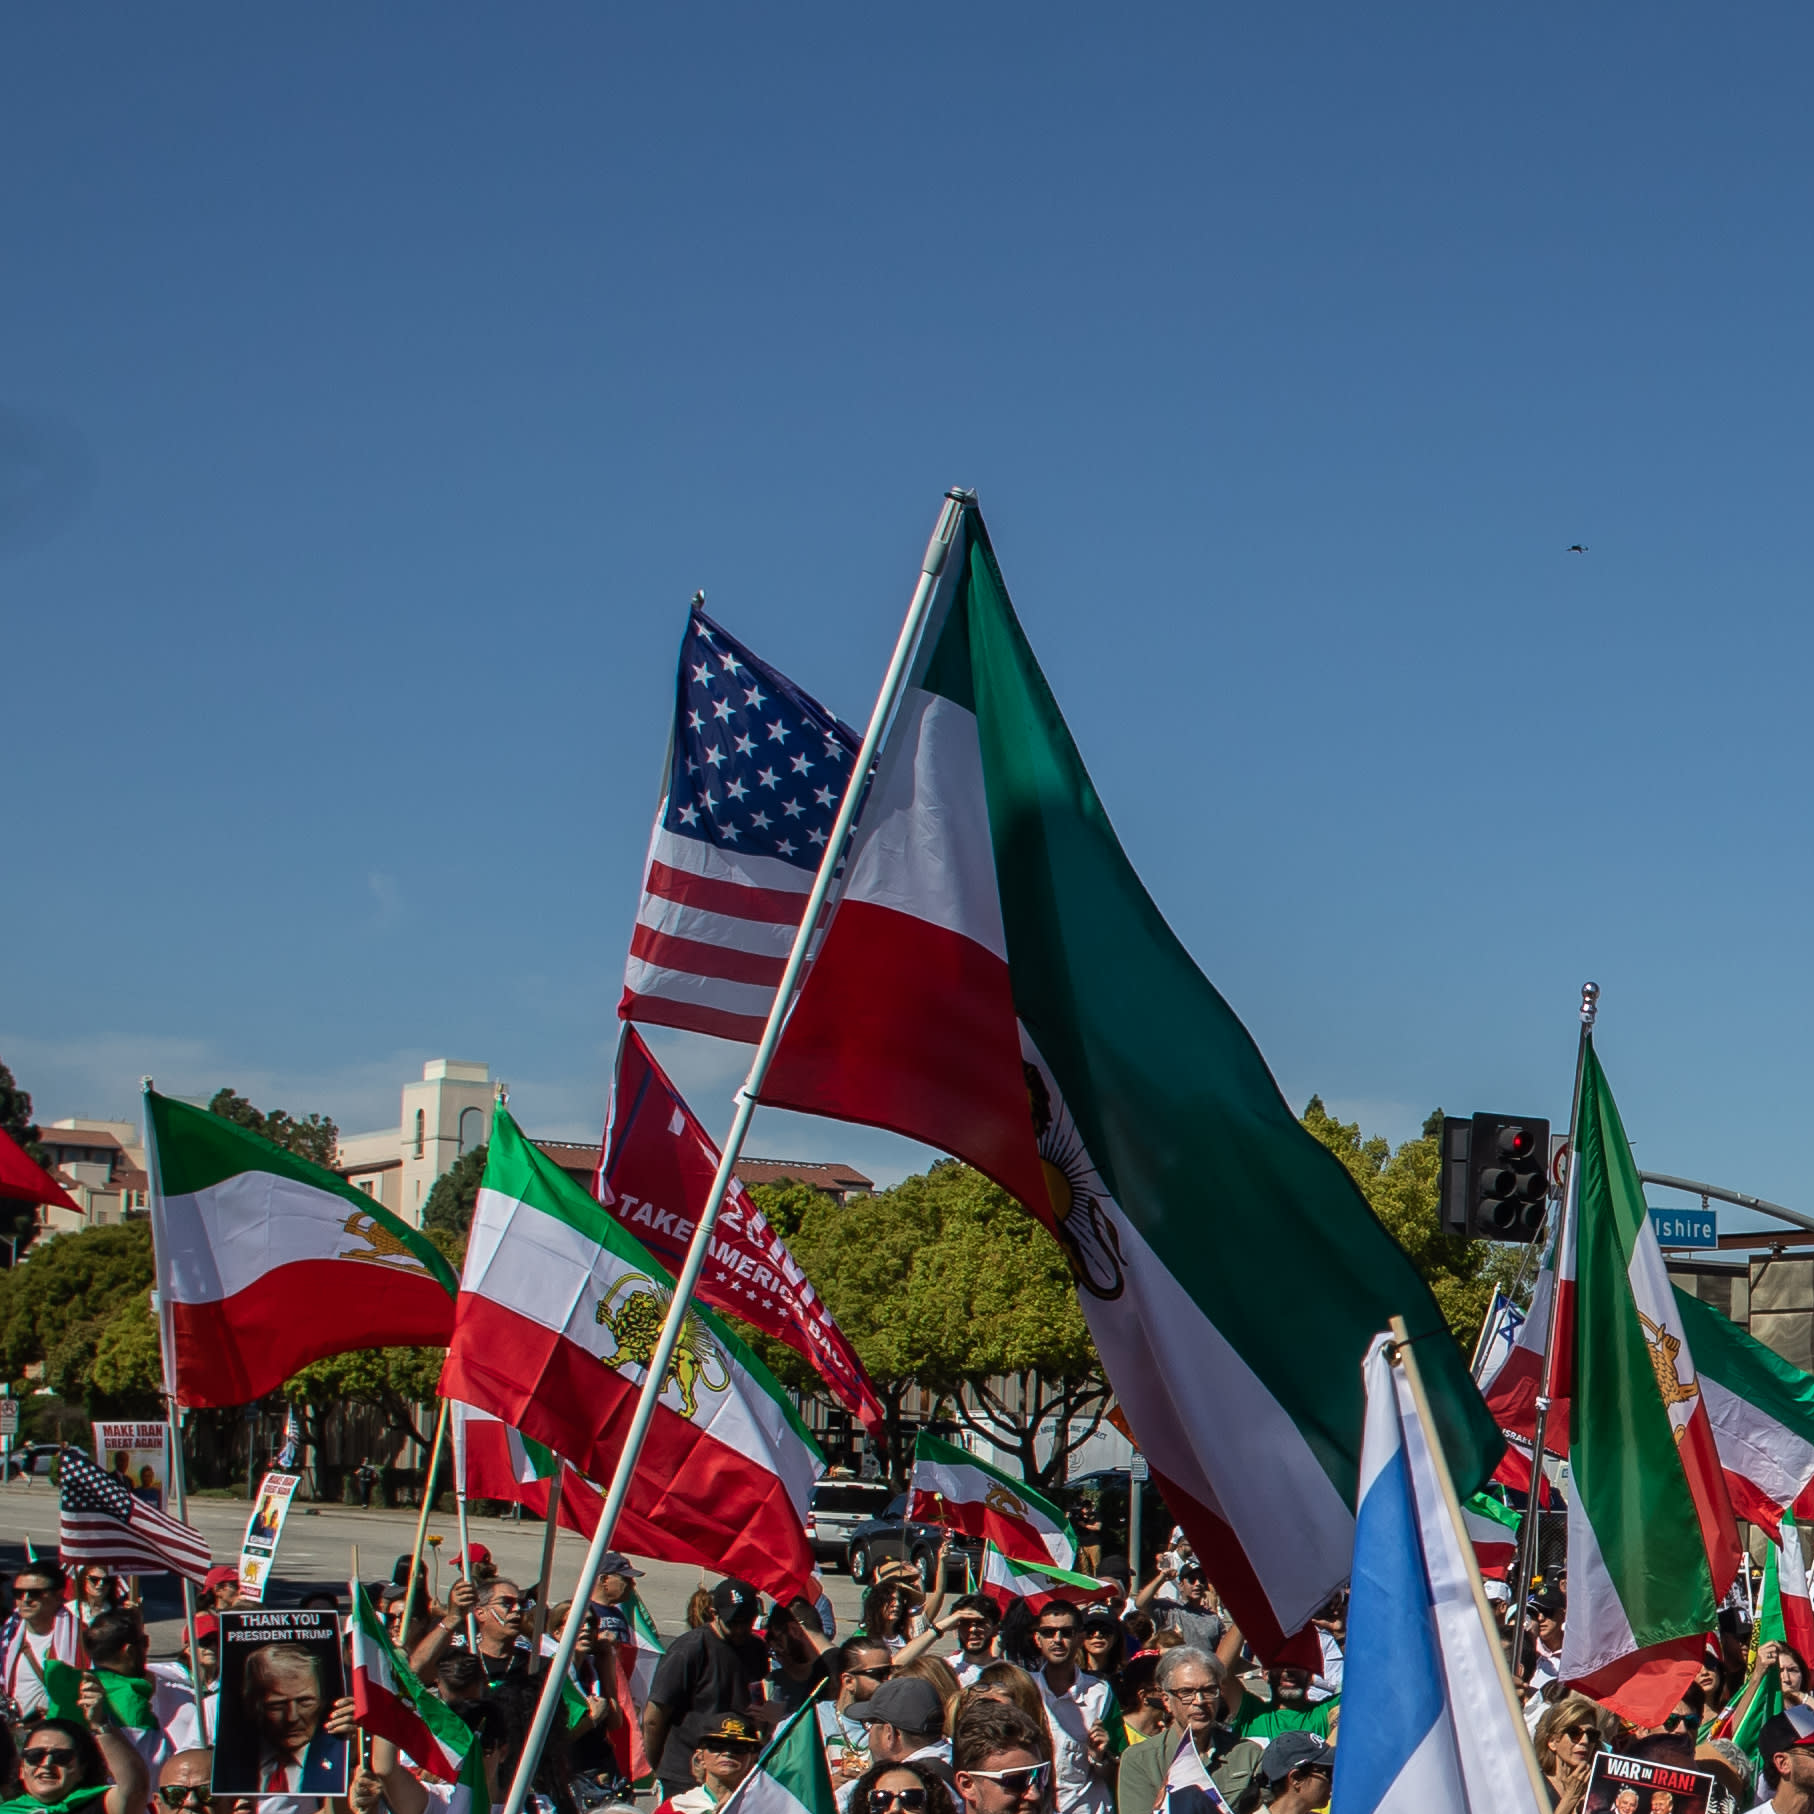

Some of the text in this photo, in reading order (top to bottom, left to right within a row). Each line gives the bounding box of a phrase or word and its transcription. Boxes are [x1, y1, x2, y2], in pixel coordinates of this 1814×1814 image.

[1656, 1218, 1711, 1238] lshire
[618, 1193, 695, 1242] TAKE
[808, 1321, 850, 1376] BA
[103, 1425, 163, 1437] MAKE IRAN
[104, 1438, 163, 1449] GREAT AGAIN
[240, 1614, 319, 1627] THANK YOU
[227, 1629, 333, 1642] PRESIDENT TRUMP
[1606, 1758, 1696, 1792] WAR IN IRAN!
